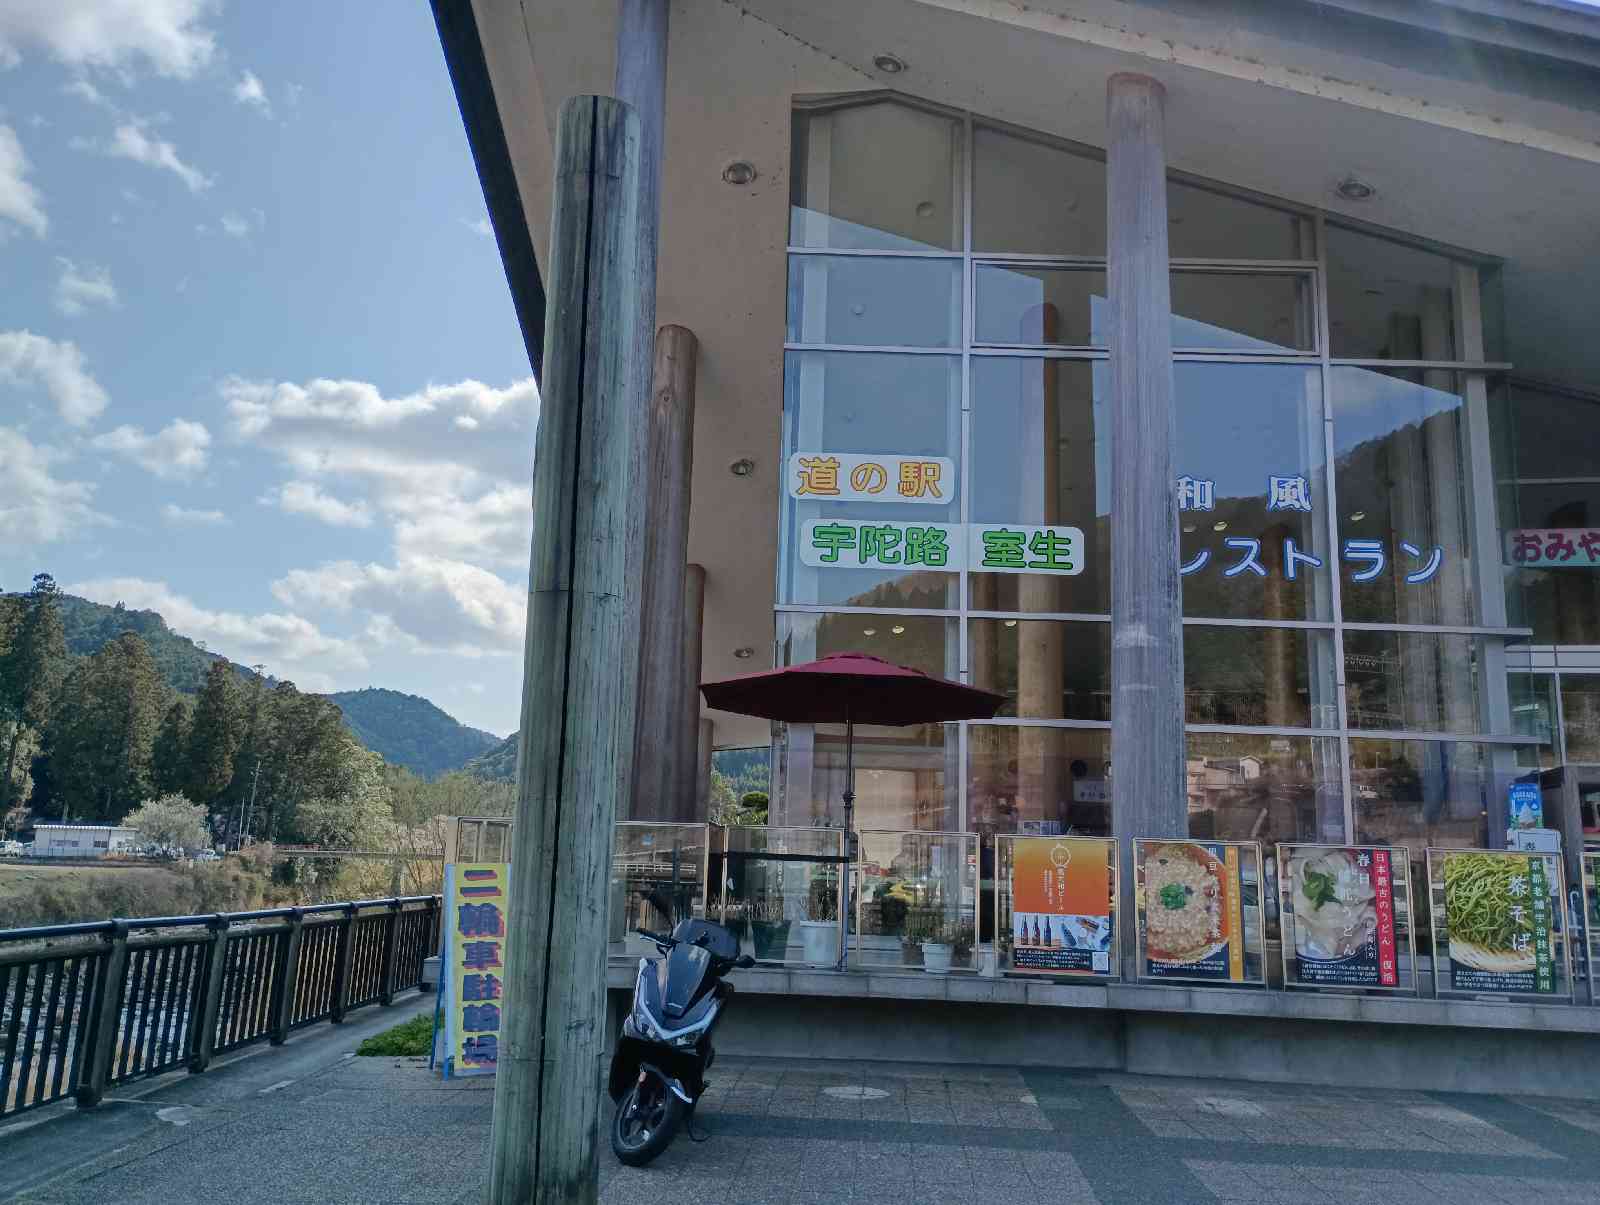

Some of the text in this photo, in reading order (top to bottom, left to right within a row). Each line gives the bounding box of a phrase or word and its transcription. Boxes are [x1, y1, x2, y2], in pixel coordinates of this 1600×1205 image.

[798, 457, 943, 497] 道の駅
[812, 523, 1073, 569] 宇陀路 室生
[1507, 874, 1531, 952] 茶そば
